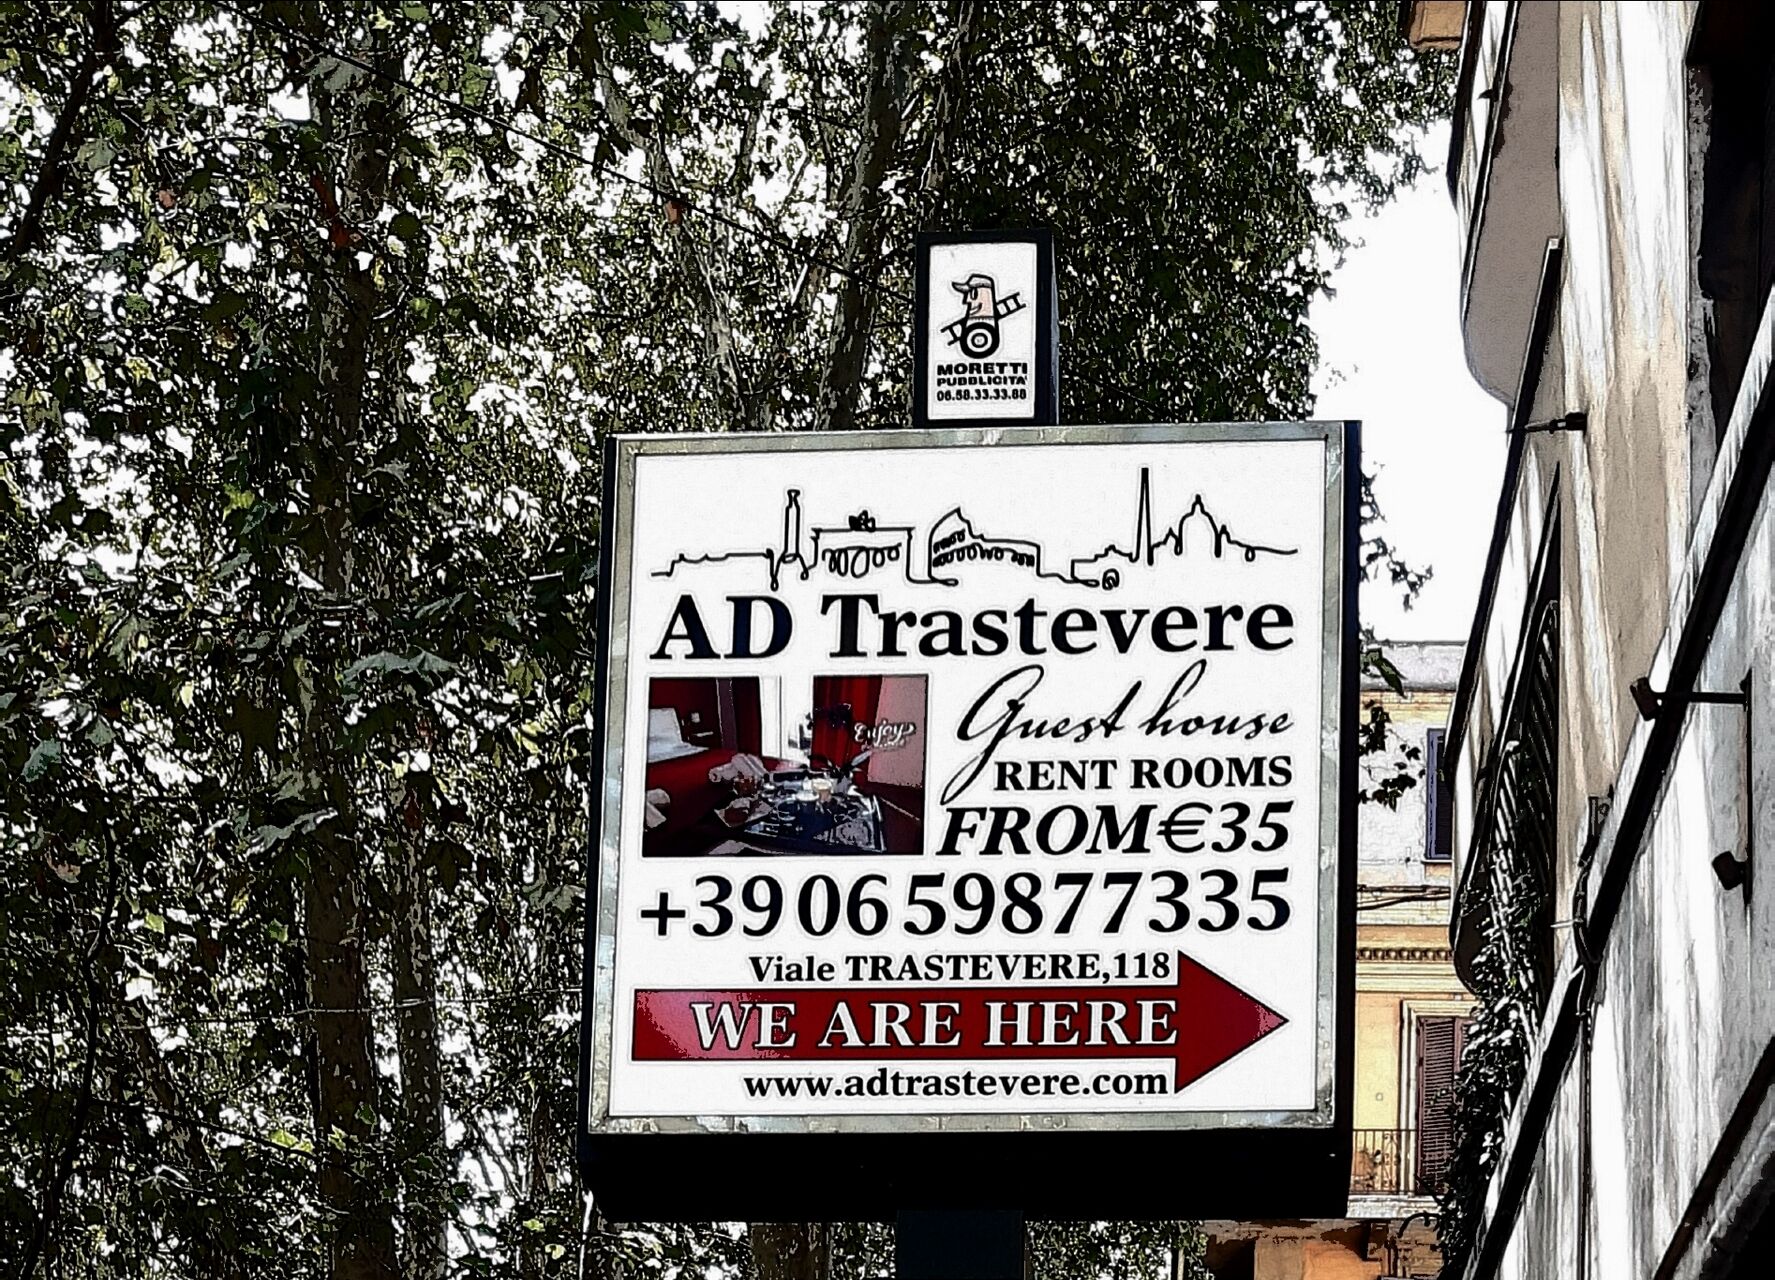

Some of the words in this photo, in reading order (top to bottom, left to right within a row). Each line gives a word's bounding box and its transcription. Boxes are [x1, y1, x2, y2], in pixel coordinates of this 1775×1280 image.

[936, 362, 1028, 376] MORETTI
[649, 594, 794, 660] AD
[820, 592, 1295, 659] Trastevere
[939, 664, 1143, 806] Guest
[1138, 658, 1294, 740] house
[993, 758, 1118, 791] RENT
[1130, 755, 1293, 789] ROOMS
[748, 955, 836, 983] Viale
[690, 1000, 798, 1050] WE
[817, 1000, 963, 1048] ARE
[984, 999, 1179, 1046] HERE
[743, 1067, 1169, 1098] www.adtrastevere.com
